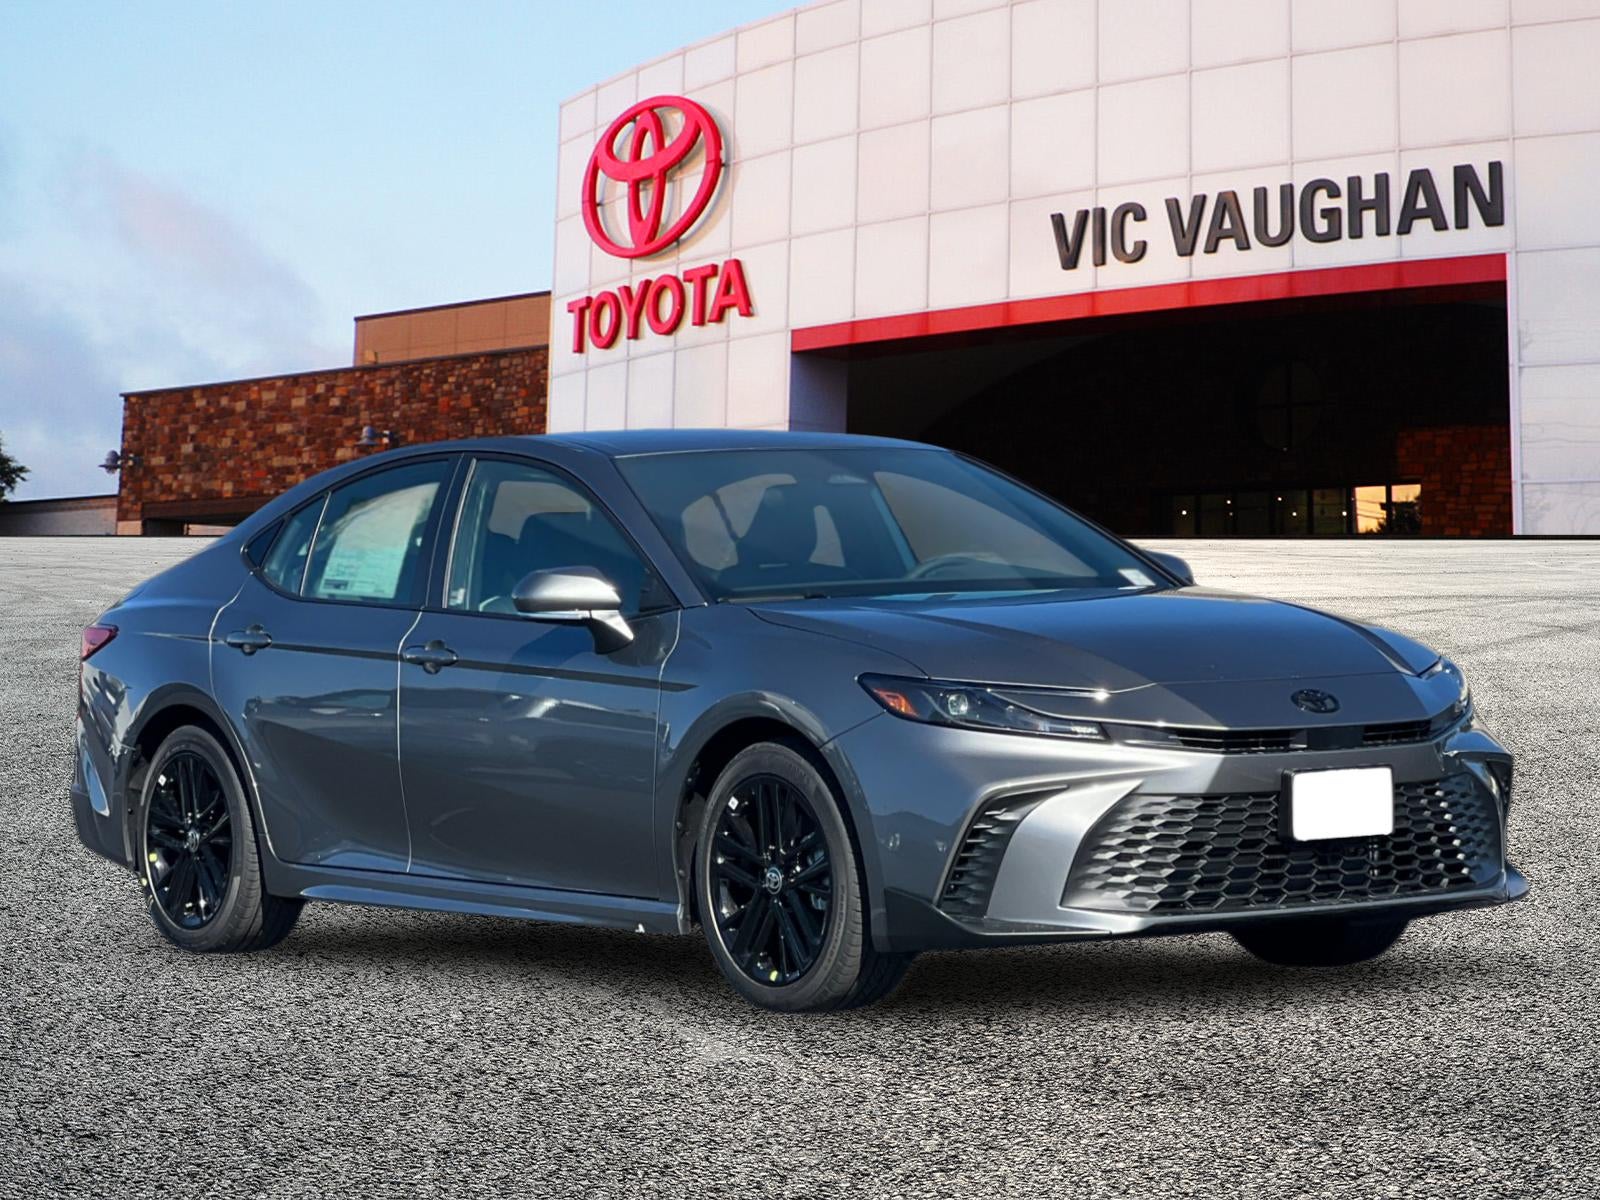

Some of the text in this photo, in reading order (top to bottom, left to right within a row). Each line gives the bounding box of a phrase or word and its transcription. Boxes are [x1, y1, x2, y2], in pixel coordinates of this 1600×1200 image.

[1050, 160, 1505, 271] VIC VAUGHAN
[567, 258, 754, 354] TOYOTA
